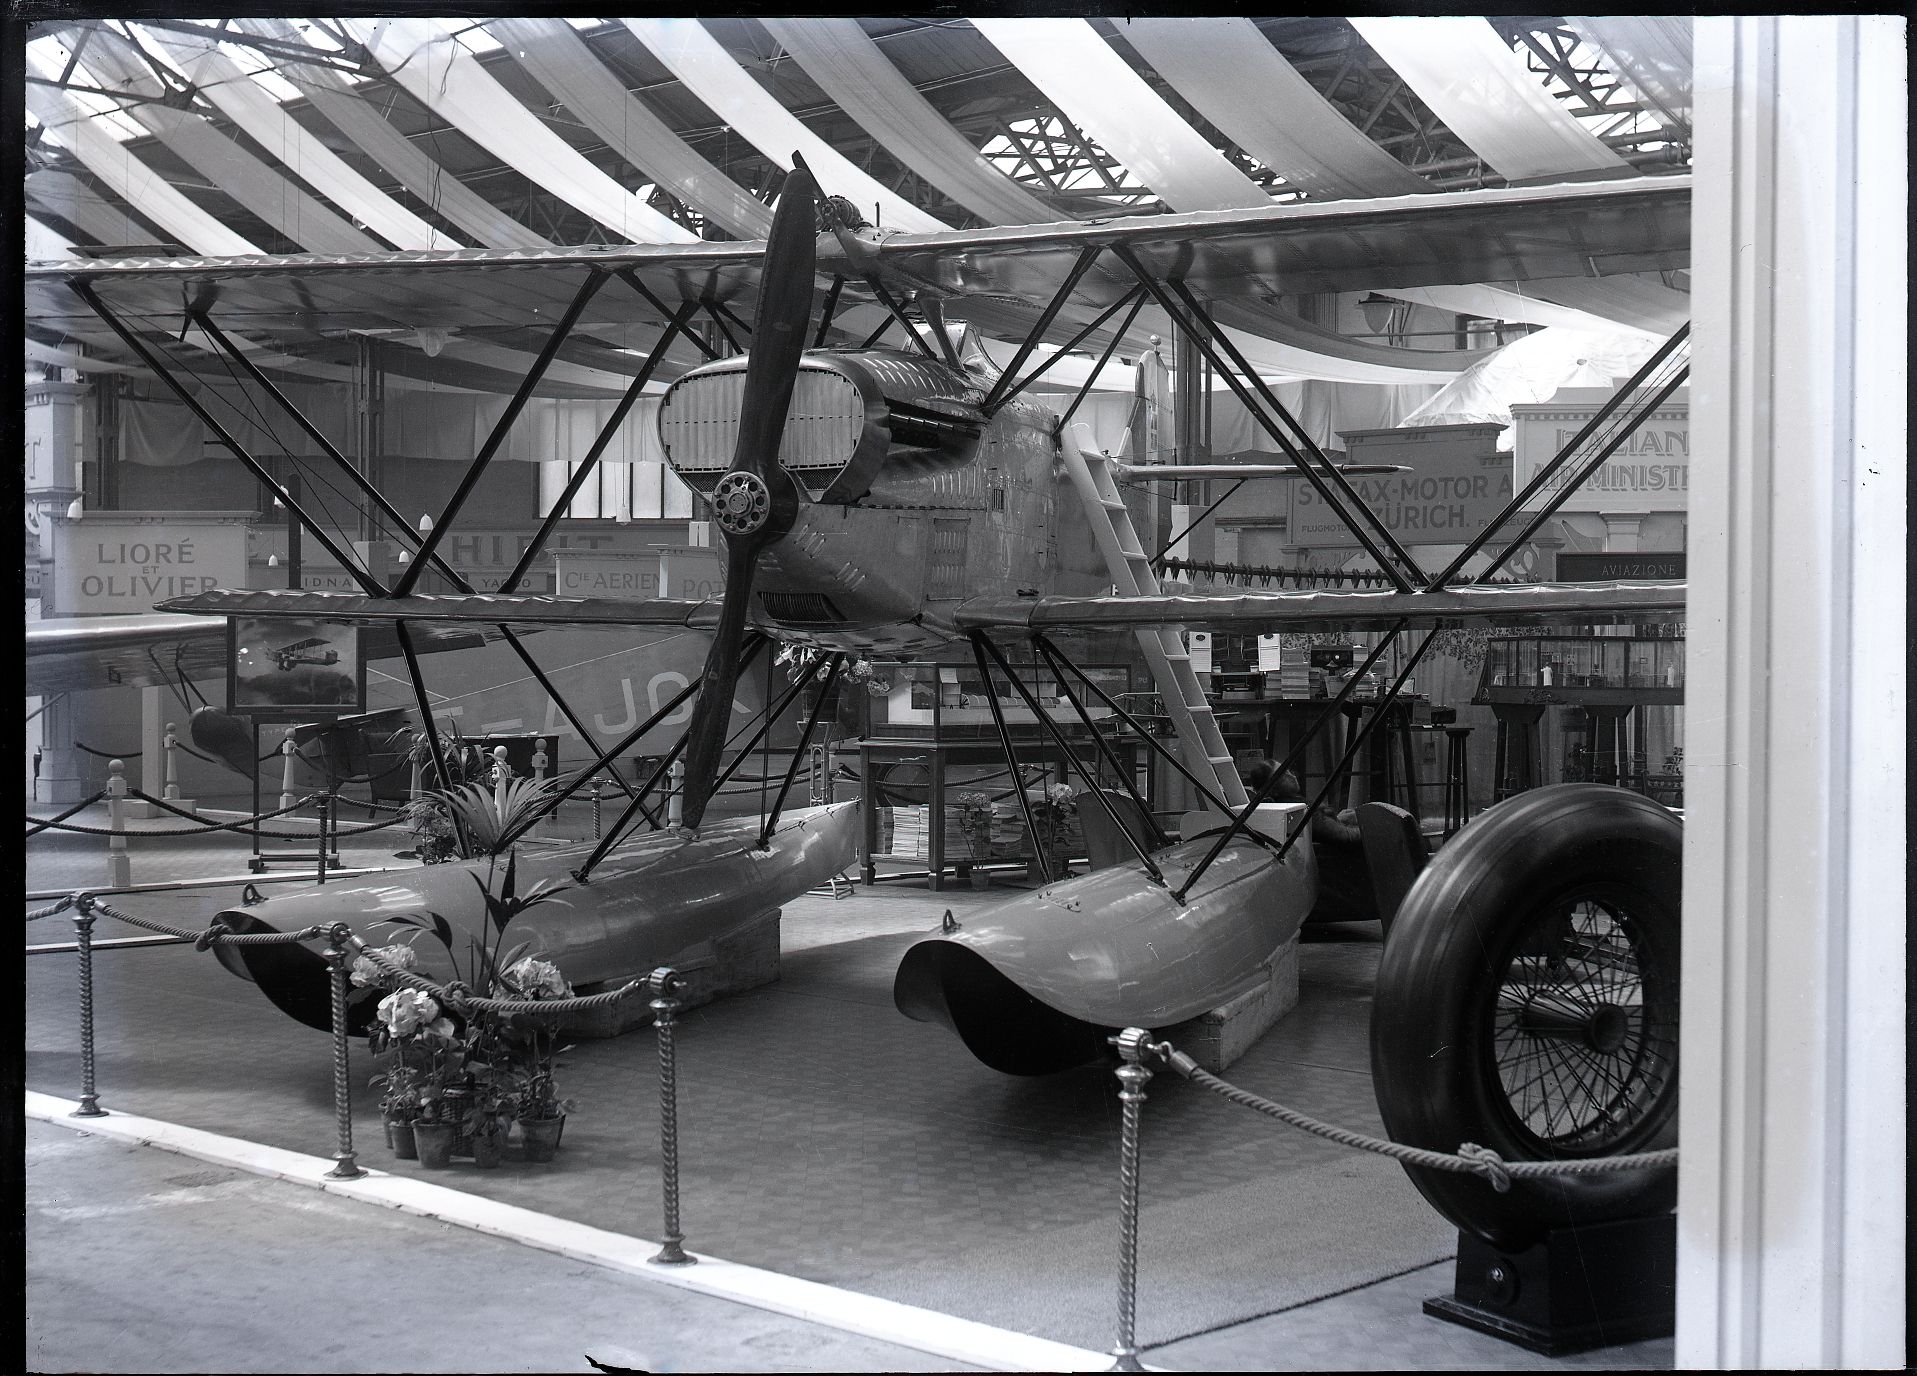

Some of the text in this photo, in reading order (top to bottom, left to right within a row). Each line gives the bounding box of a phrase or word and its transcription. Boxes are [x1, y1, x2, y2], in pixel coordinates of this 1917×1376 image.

[1555, 429, 1689, 456] ITALIAN
[1531, 463, 1576, 491] AIR
[1302, 524, 1351, 533] FLUGMOTO
[98, 538, 195, 564] LIORÉ
[142, 566, 160, 574] ET
[1602, 565, 1676, 576] AVIAZIONE
[482, 578, 531, 588] YAO
